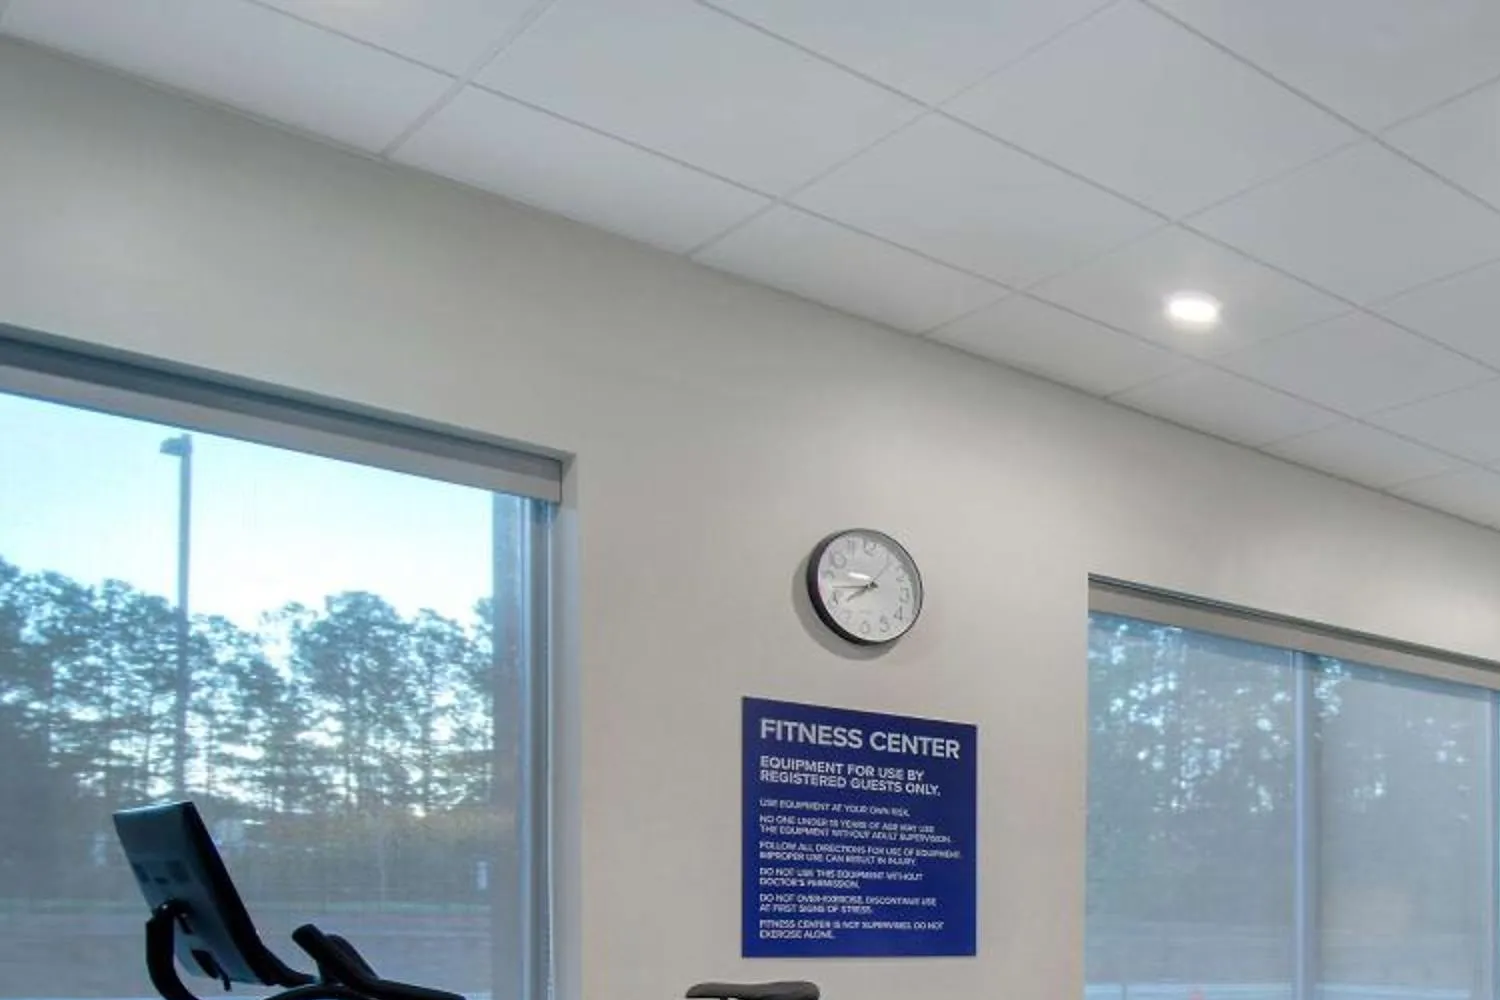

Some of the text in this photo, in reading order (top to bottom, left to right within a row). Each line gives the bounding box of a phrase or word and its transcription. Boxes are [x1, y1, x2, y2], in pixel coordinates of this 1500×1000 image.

[760, 718, 960, 759] FITNESS CENTER
[760, 756, 924, 781] EQUIPMENT FOR USE BY
[760, 770, 940, 796] REGISTERED GUESTS ONLY.
[776, 816, 796, 824] ONE
[798, 818, 828, 826] UNDER
[760, 842, 796, 850] FOLLOW
[798, 844, 814, 852] ALL
[816, 844, 866, 854] DIRECTIONS
[826, 854, 844, 862] CAN
[760, 868, 773, 876] DO
[776, 868, 794, 876] NOT
[760, 893, 774, 901] DO
[760, 920, 796, 928] FITNESS
[798, 920, 831, 928] CENTER
